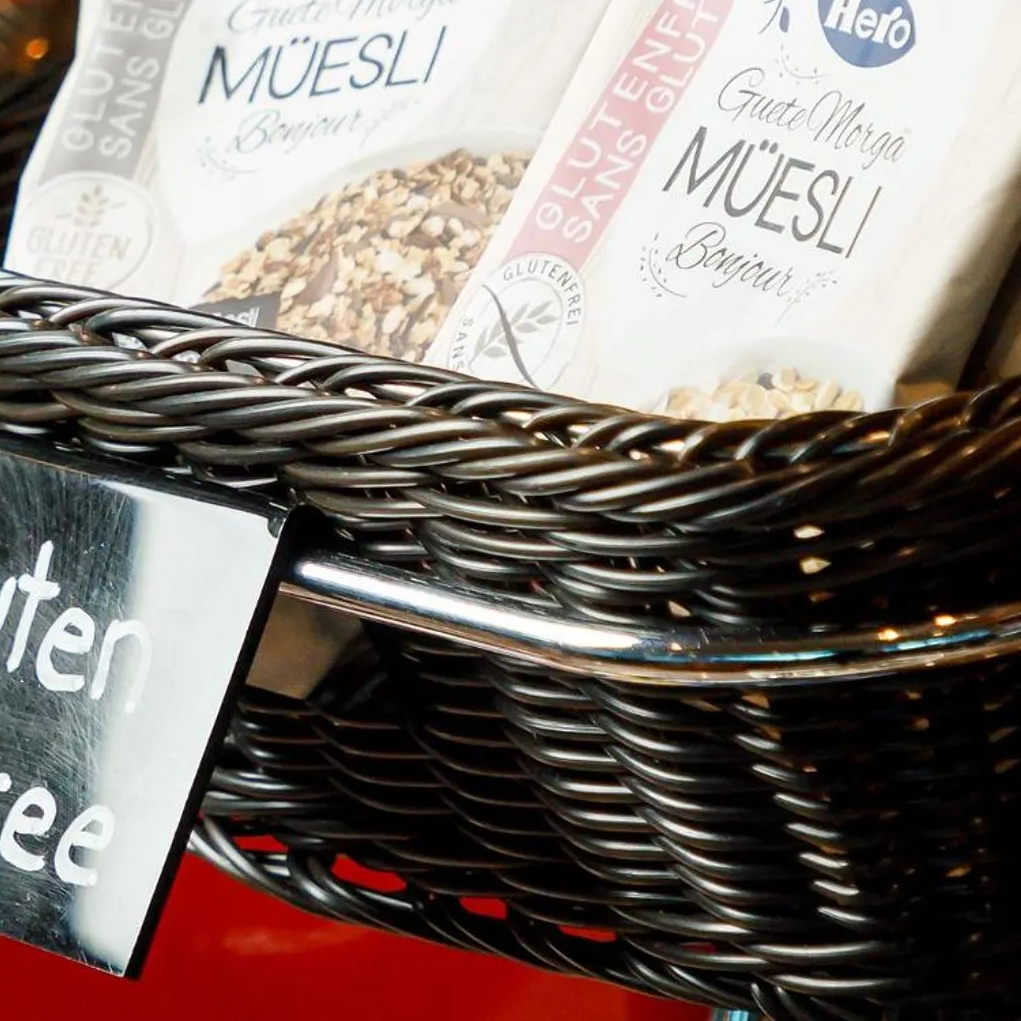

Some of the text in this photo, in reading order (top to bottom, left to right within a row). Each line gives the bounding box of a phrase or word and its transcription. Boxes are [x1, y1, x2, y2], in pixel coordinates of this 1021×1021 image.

[197, 25, 448, 105] MÜESLI
[717, 66, 807, 122] Guete
[98, 55, 161, 161] SANS
[233, 109, 364, 155] Bonjour
[562, 128, 647, 244] SANS
[661, 125, 883, 260] MÜESLI
[25, 226, 133, 262] GLUTEN
[665, 221, 798, 298] Bonjour
[502, 258, 582, 327] GLUTENFREI
